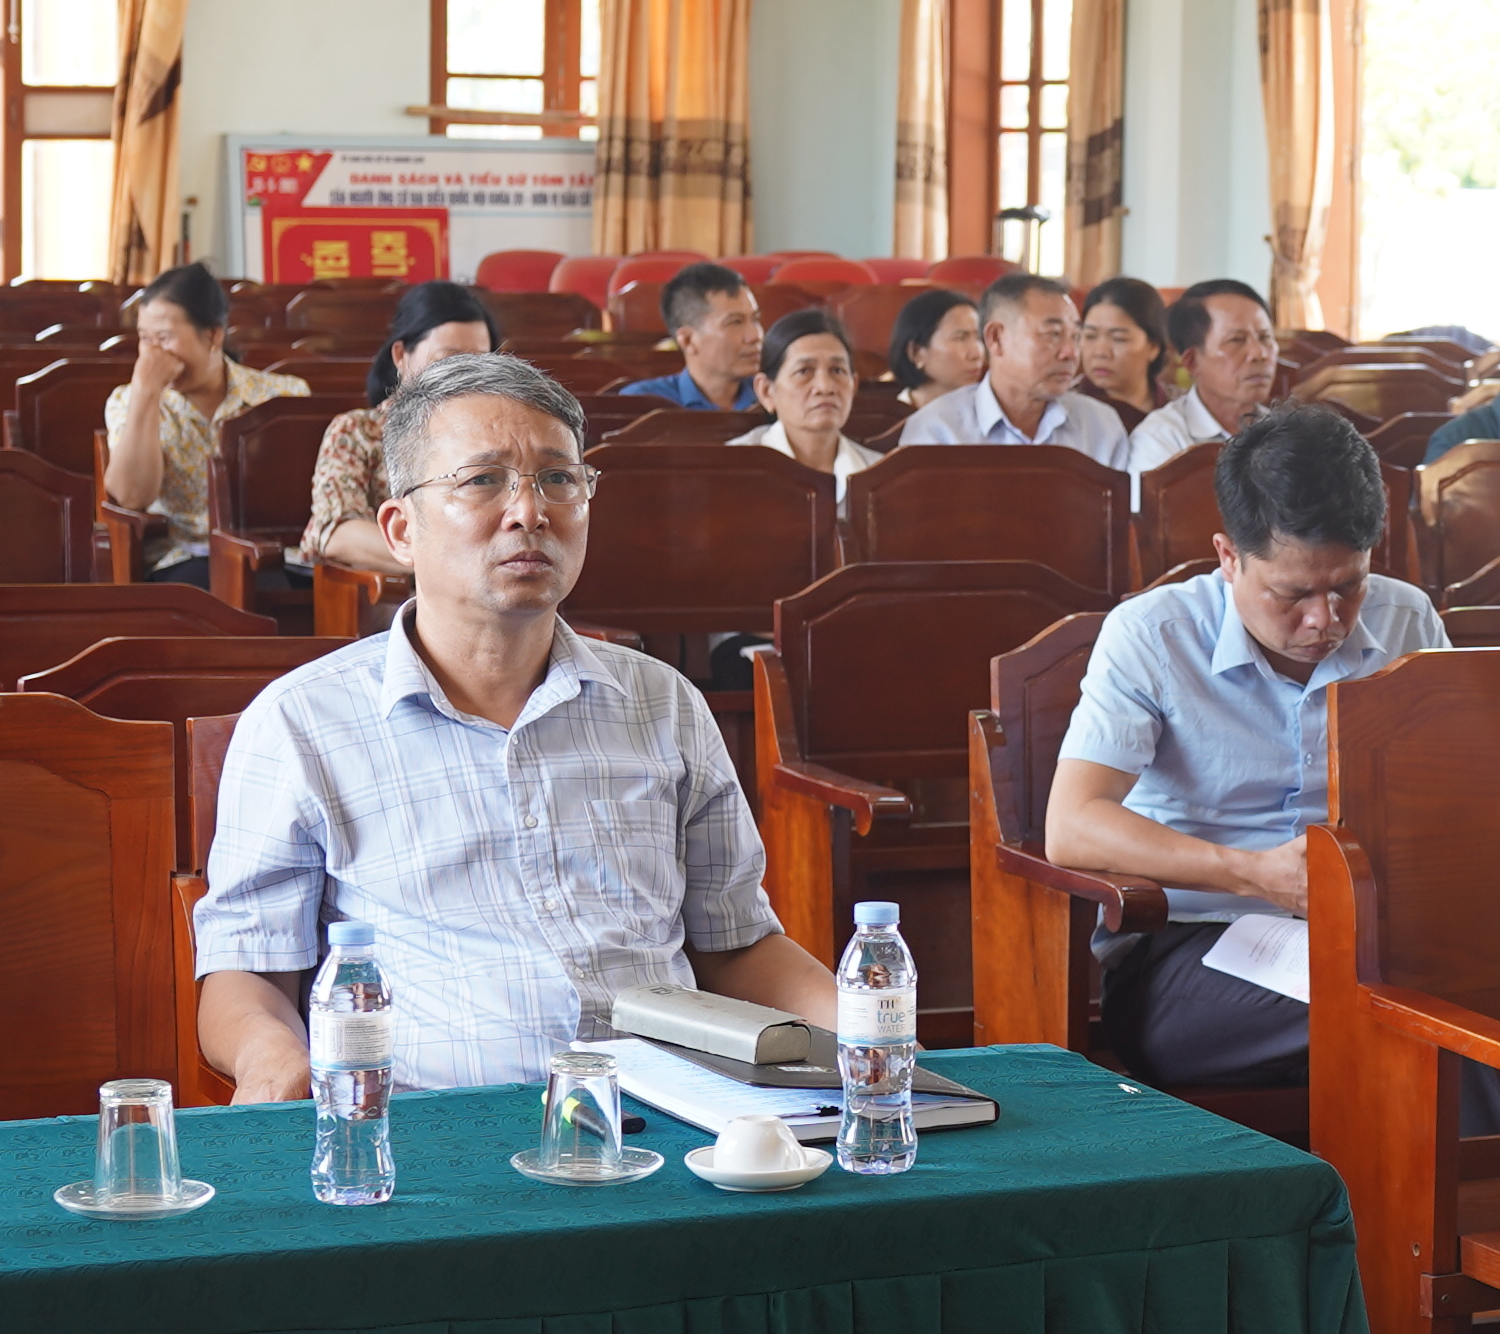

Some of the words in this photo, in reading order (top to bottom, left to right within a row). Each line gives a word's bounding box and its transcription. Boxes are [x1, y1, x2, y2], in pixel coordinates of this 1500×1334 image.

[877, 998, 895, 1009] TH
[877, 1010, 906, 1024] true
[878, 1024, 906, 1033] WATER
